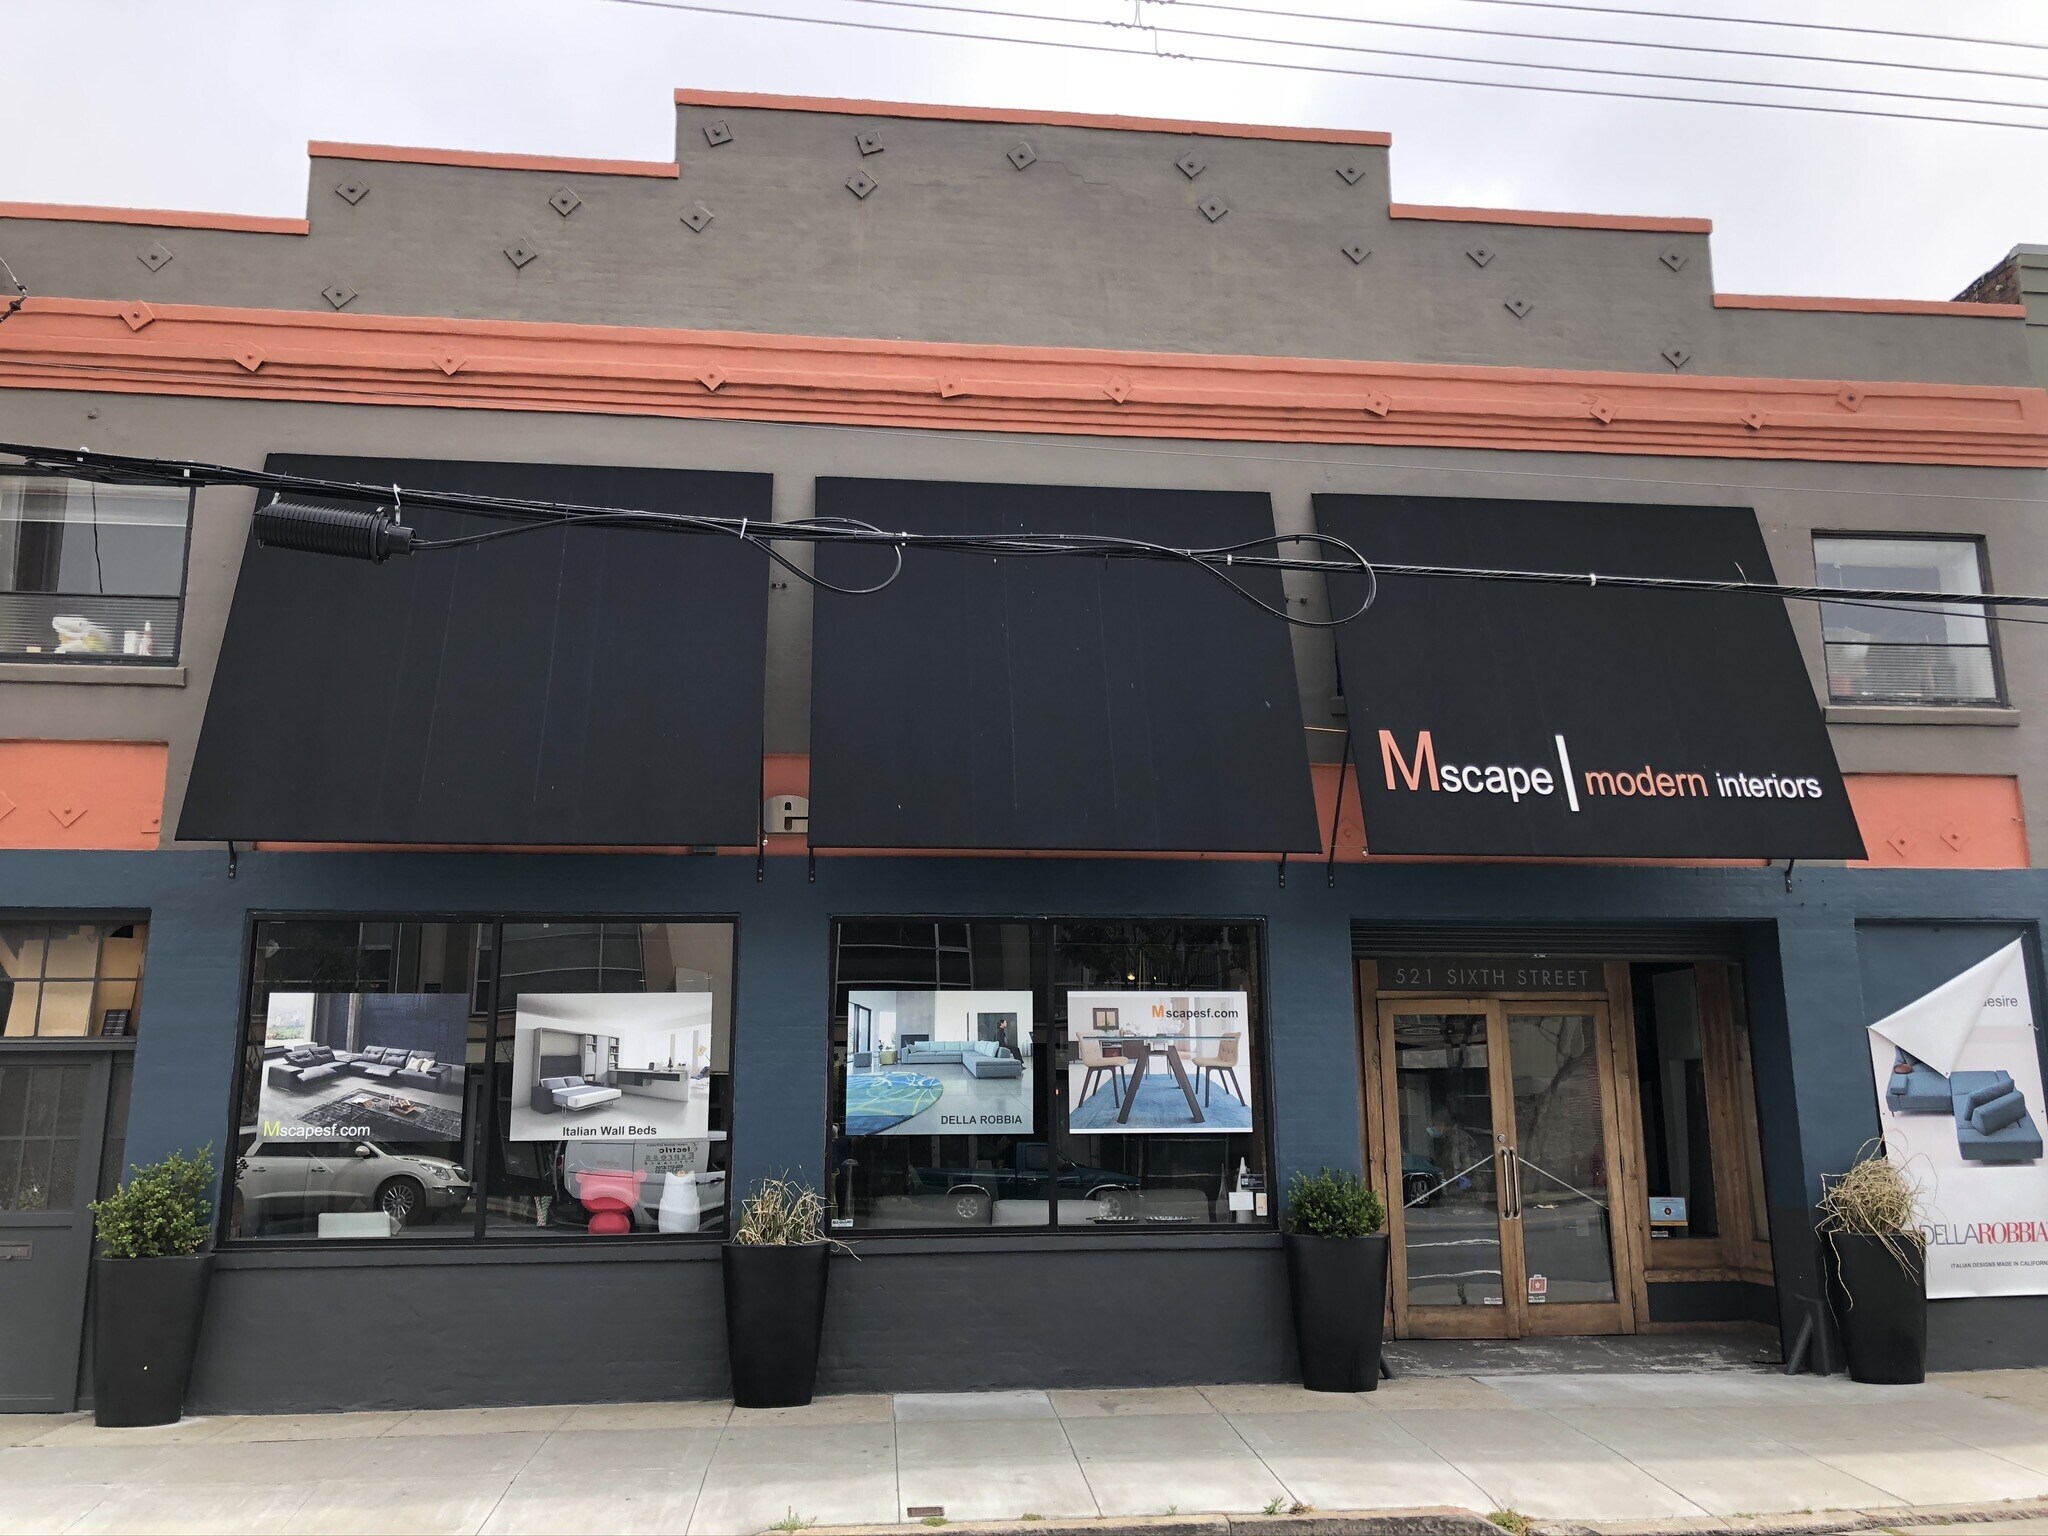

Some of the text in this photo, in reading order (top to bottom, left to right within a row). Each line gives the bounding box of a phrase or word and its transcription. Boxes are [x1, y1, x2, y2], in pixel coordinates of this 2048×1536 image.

[1378, 729, 1823, 802] Mscape modern interiors
[1395, 968, 1589, 986] 521 SIXTH STREET
[1151, 1005, 1239, 1020] Mscapesf.com
[941, 1115, 1023, 1125] DELLA ROBBIA
[263, 1120, 371, 1140] Mscapesf.com
[562, 1125, 657, 1137] Italian Wall Beds
